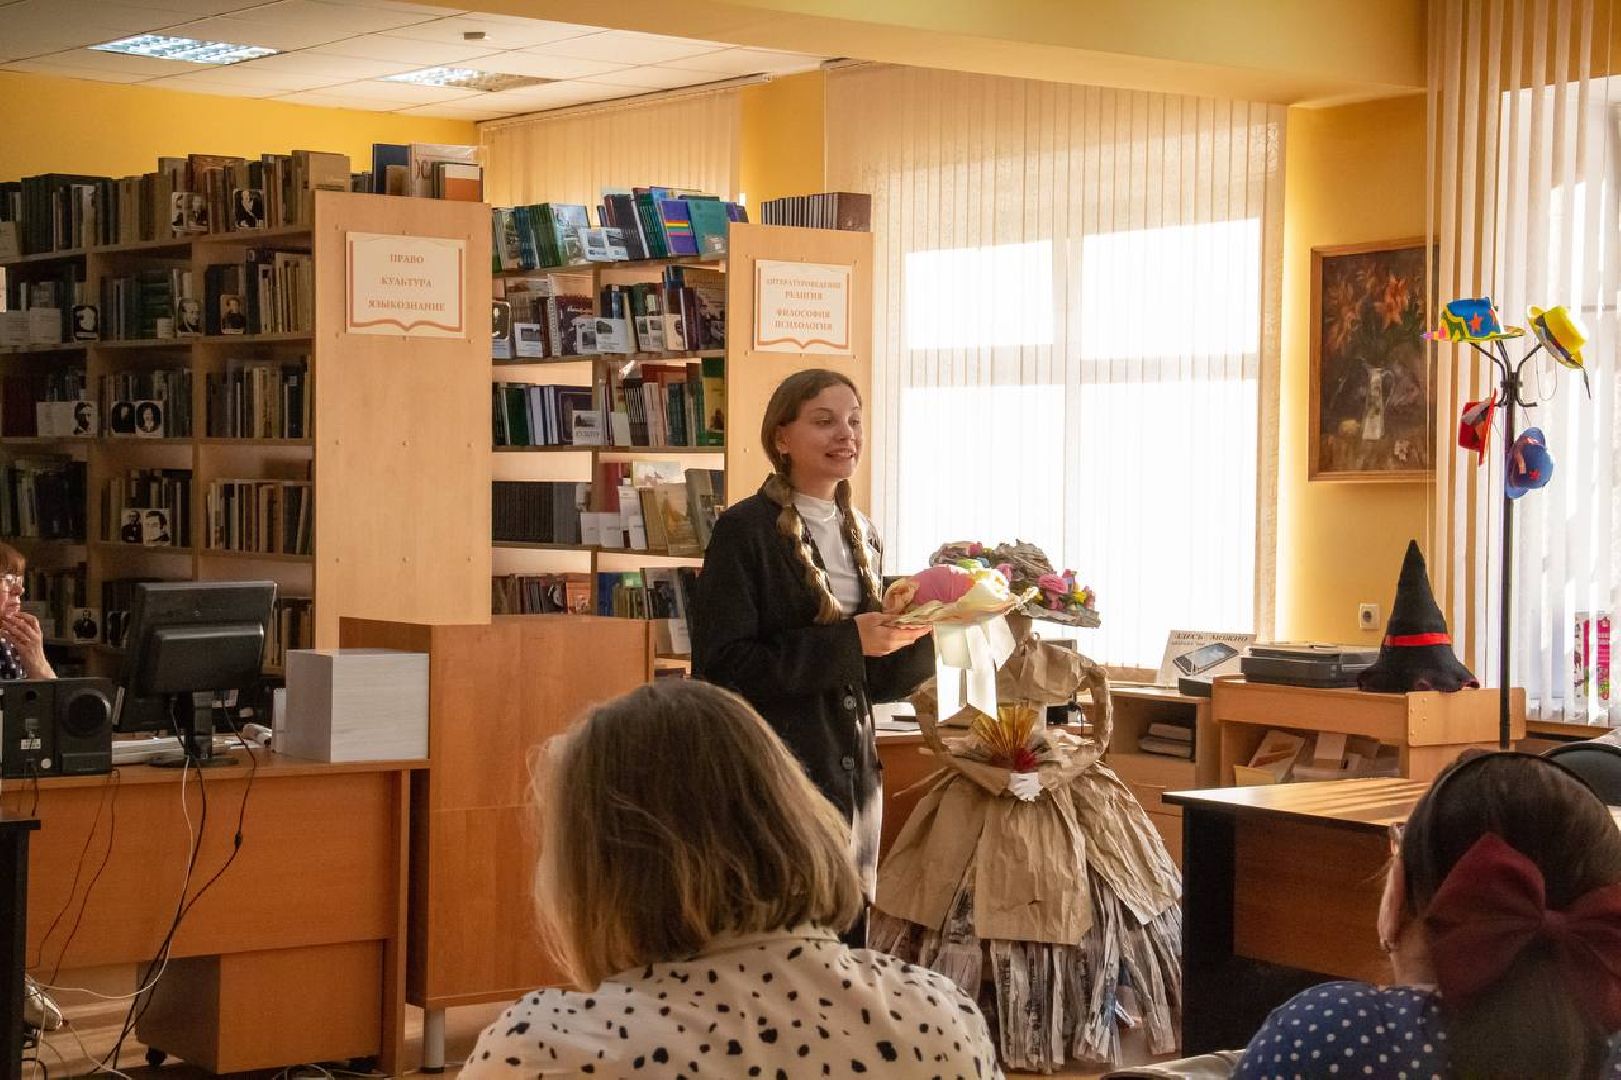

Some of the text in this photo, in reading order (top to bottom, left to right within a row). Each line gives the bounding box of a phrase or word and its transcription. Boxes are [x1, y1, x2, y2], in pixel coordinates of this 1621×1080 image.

[390, 253, 425, 264] ПРАВО
[381, 276, 432, 288] КУЛЬТУРА
[368, 299, 446, 312] ЯЗЫКОЗНАНИЕ
